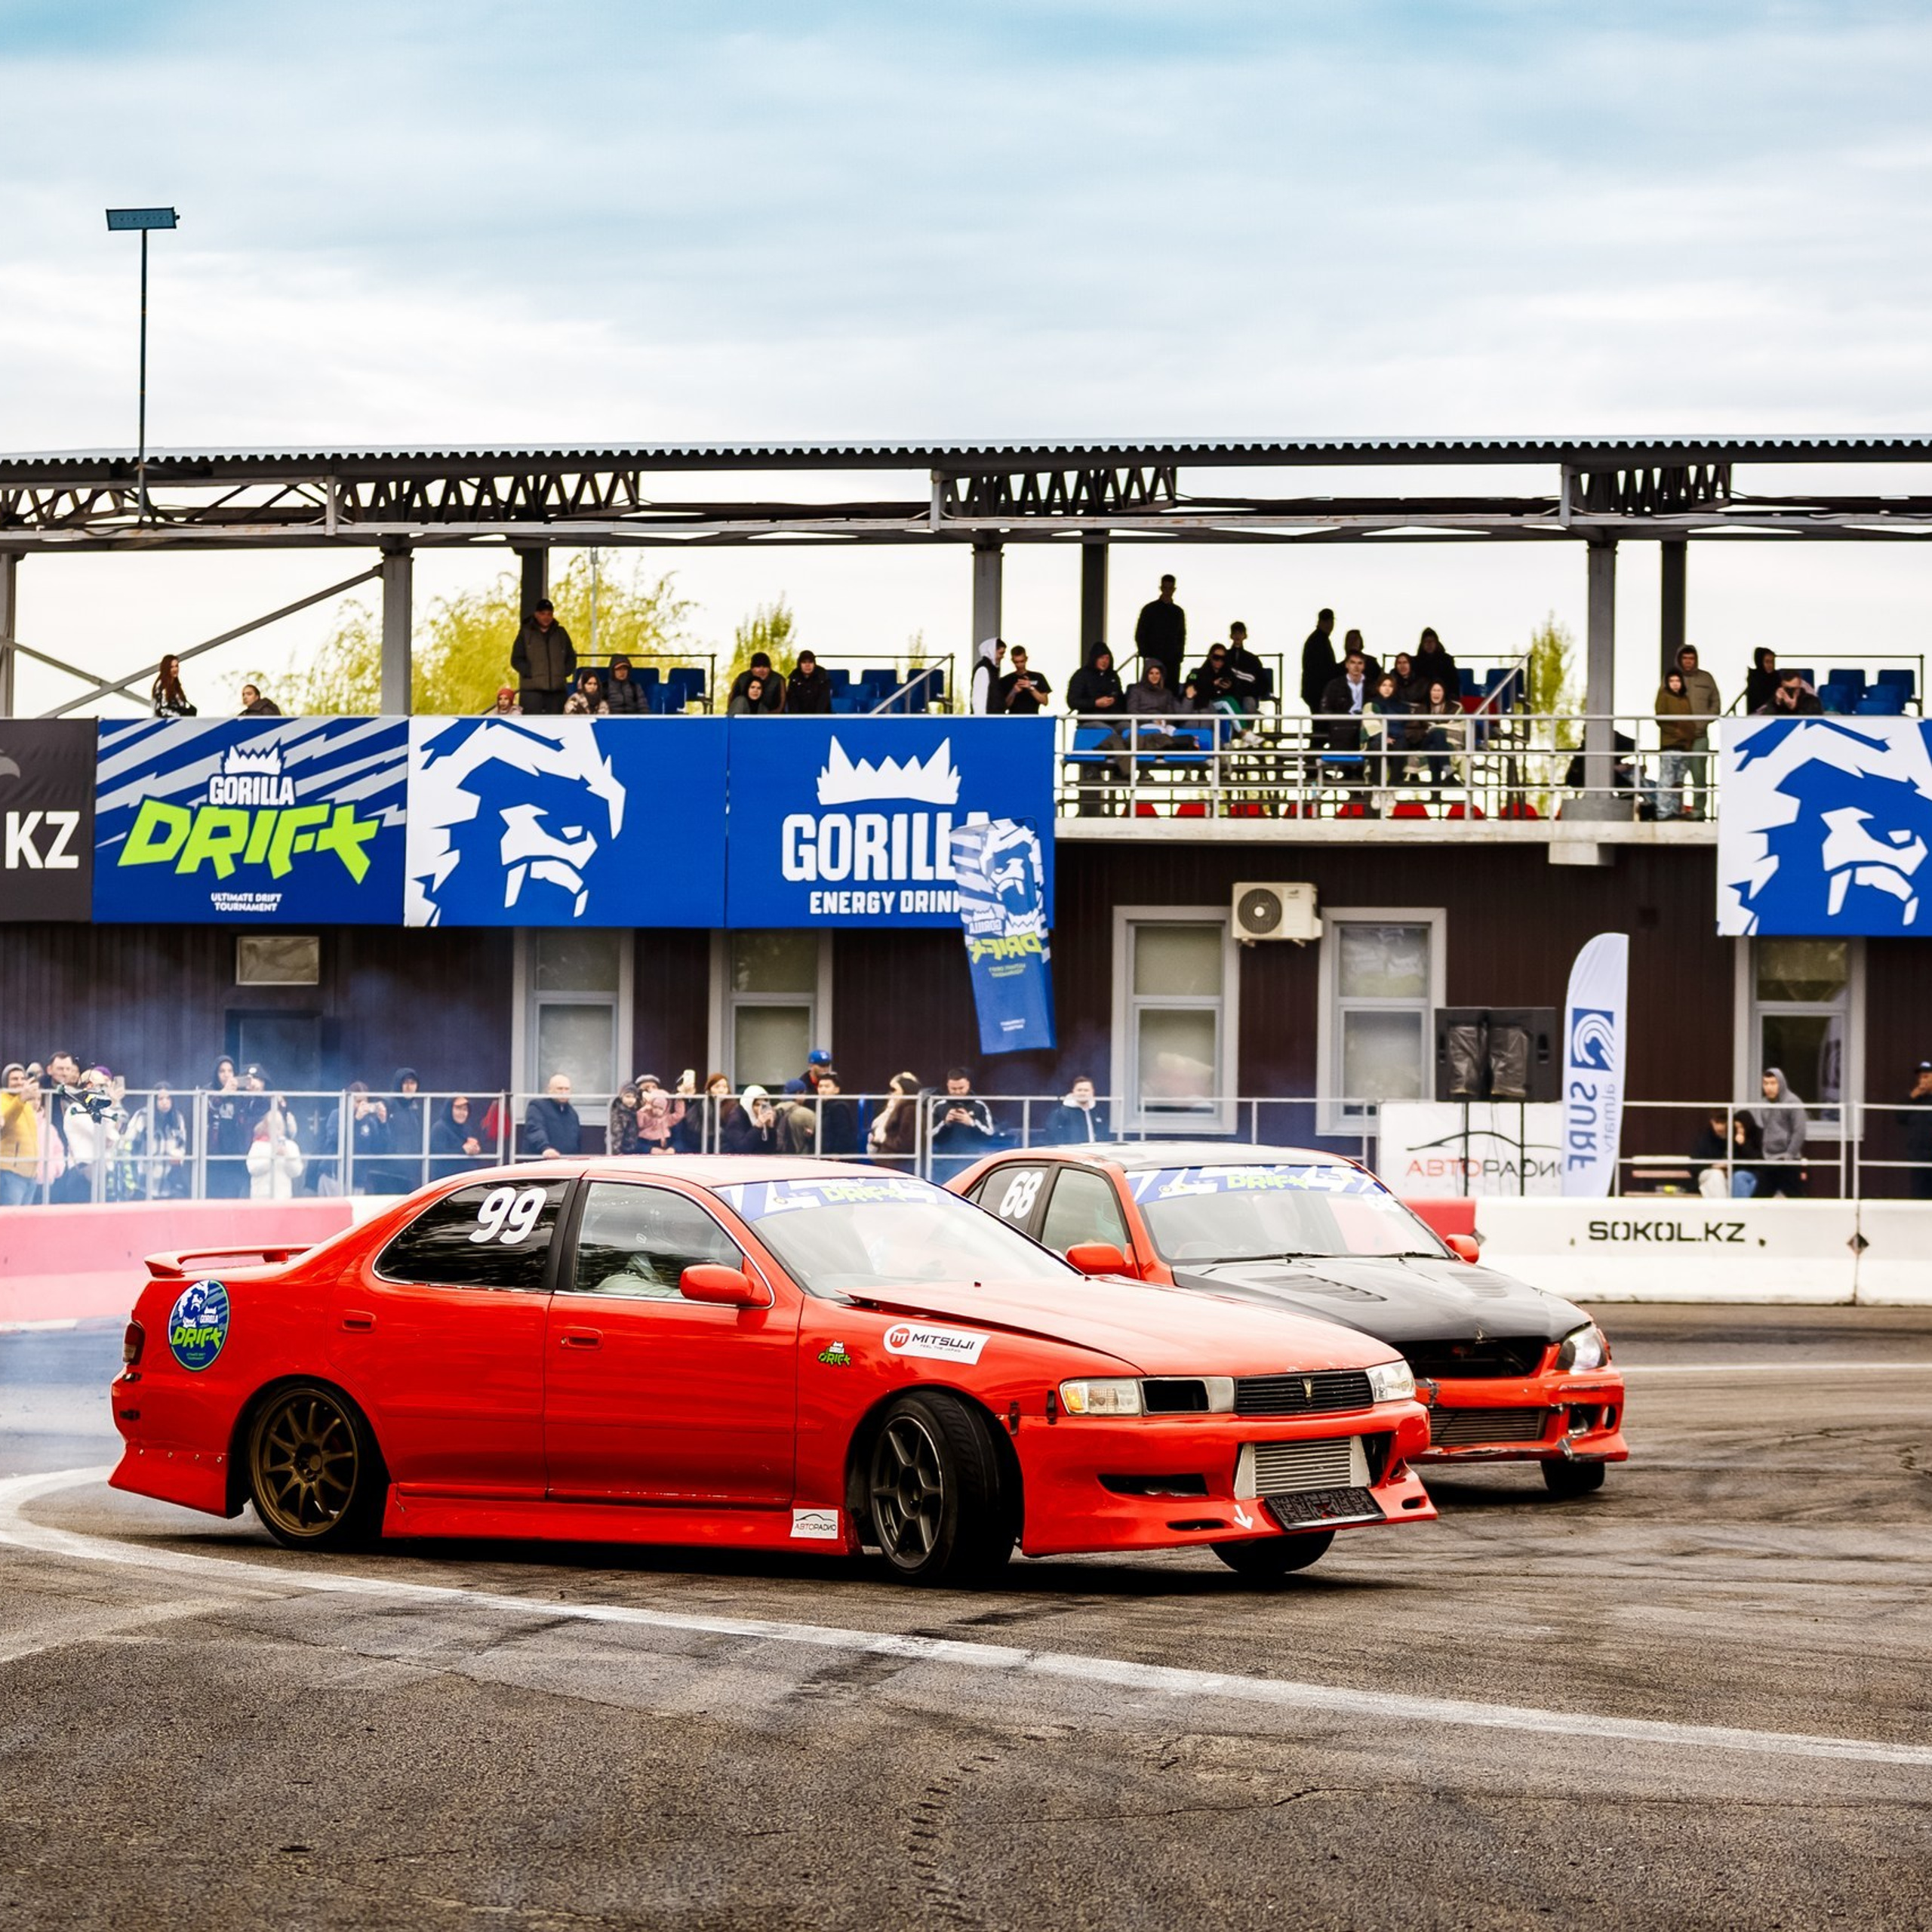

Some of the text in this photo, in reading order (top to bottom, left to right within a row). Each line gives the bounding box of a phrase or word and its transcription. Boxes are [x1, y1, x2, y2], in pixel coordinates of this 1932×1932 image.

[209, 776, 295, 805] GORILLA
[5, 811, 80, 869] KZ
[118, 799, 379, 884] DRIFT
[782, 811, 989, 881] GORILL
[211, 892, 282, 903] ULTIMATE DRIFT
[214, 902, 278, 912] TOURNAMENT
[810, 891, 895, 914] ENERGY
[998, 1171, 1044, 1219] 68
[469, 1186, 547, 1244] 99
[1589, 1221, 1746, 1242] SOKOL.KZ
[172, 1327, 223, 1349] DRIFT
[912, 1333, 975, 1349] MITSUJI
